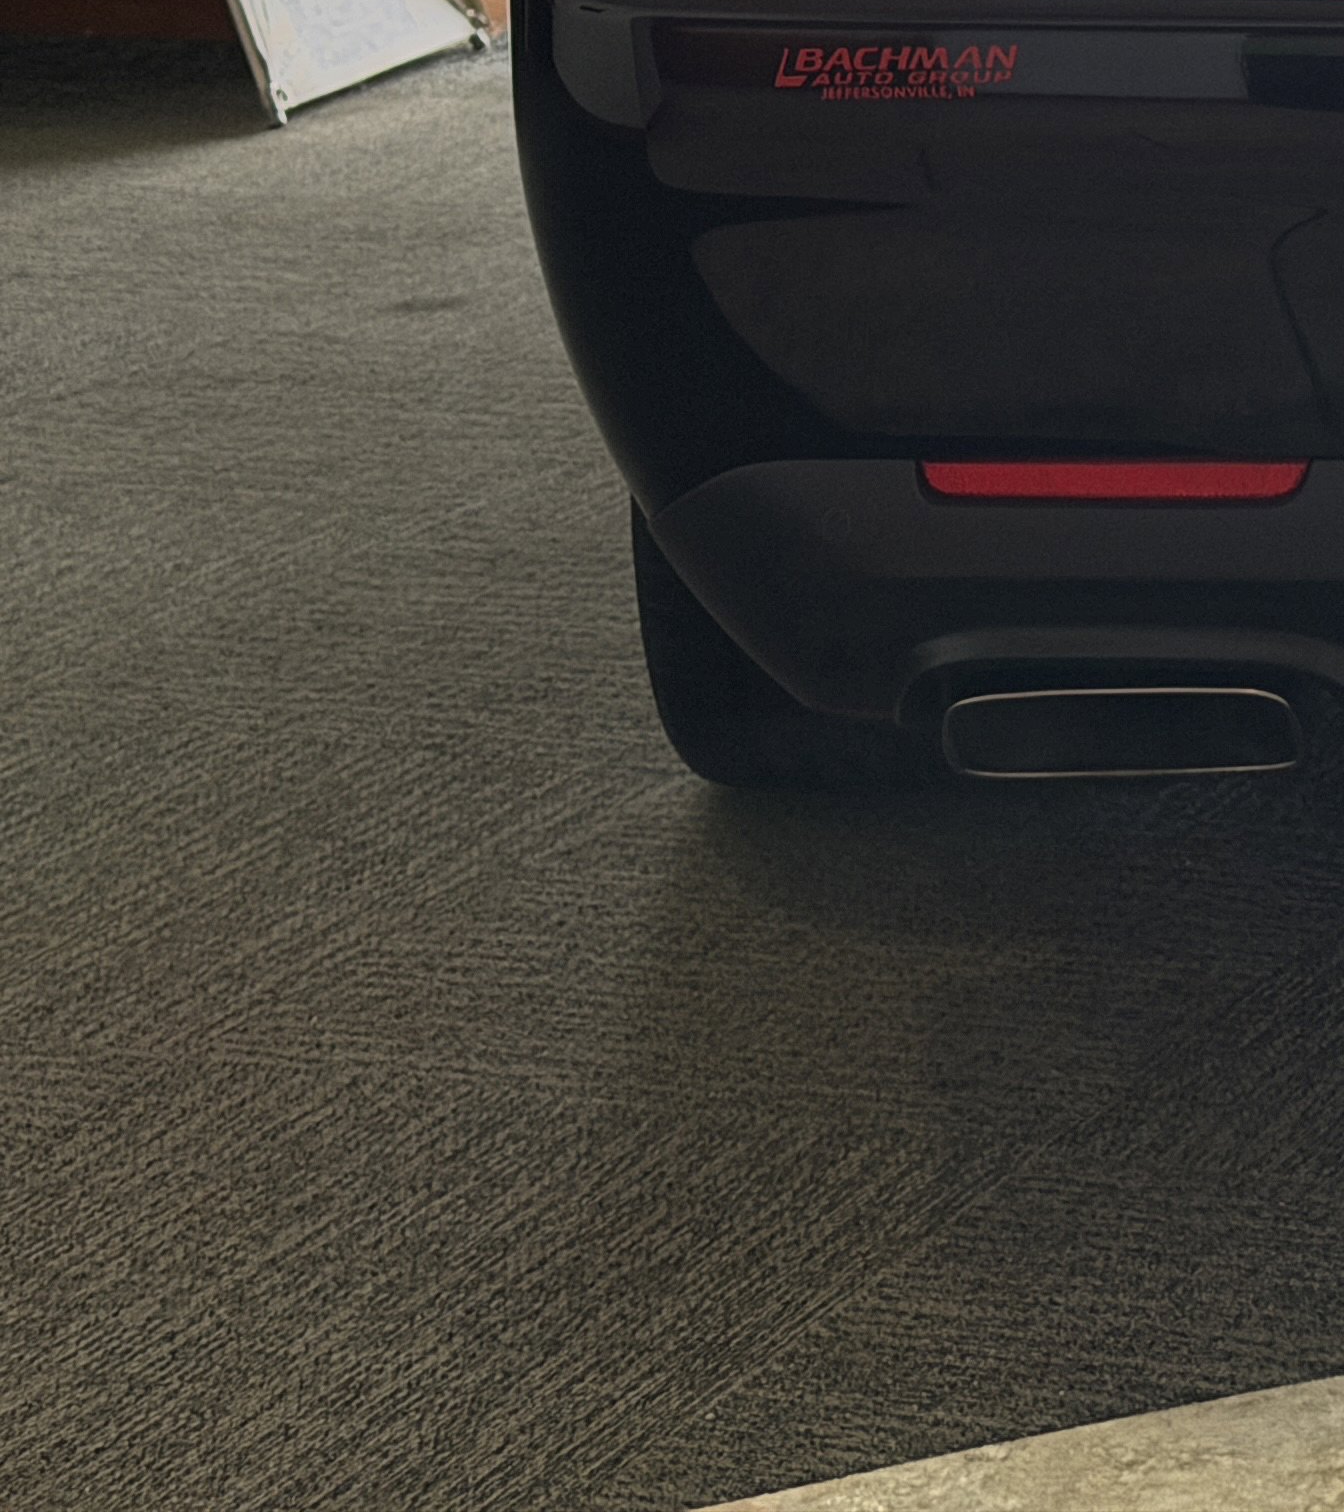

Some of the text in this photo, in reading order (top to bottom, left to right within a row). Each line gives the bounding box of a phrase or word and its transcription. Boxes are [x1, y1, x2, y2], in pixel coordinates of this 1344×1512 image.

[794, 45, 1019, 72] BACHMAN
[811, 70, 1012, 87] AUTO GROUP
[820, 85, 976, 101] JEFFERSONVILLE, IN
